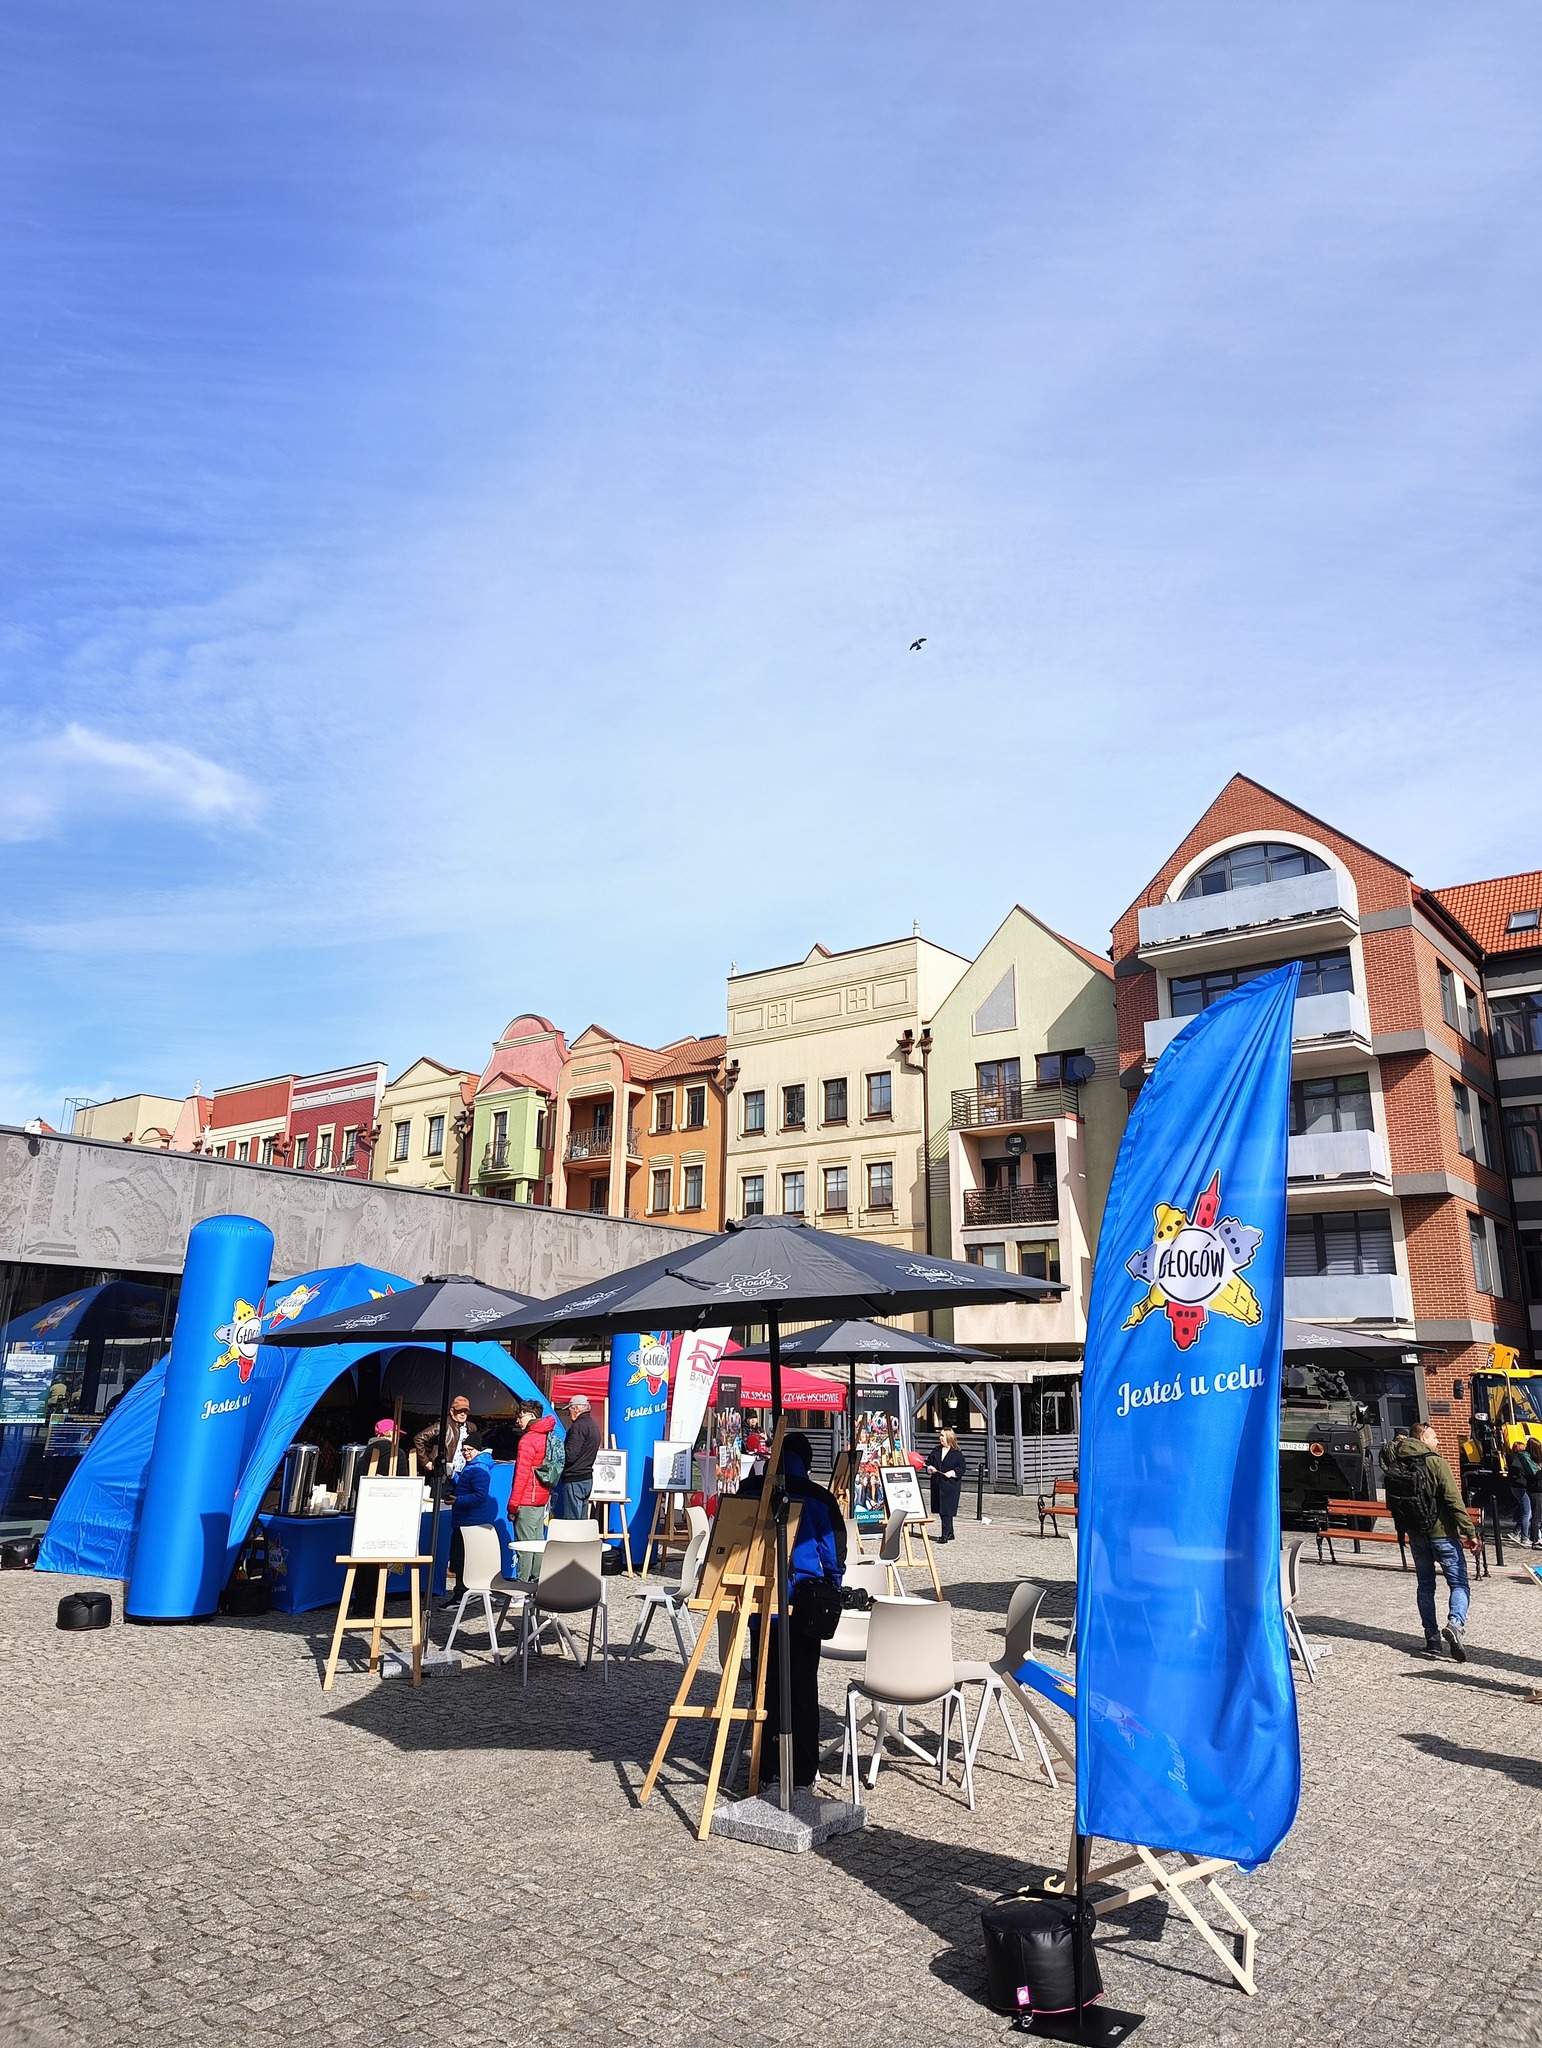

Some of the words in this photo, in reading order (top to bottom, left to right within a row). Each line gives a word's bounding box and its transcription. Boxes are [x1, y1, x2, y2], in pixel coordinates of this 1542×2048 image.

[1158, 1241, 1225, 1279] GŁOGÓW
[690, 1371, 712, 1387] BANK
[1116, 1373, 1186, 1417] Jesteś
[1190, 1374, 1210, 1396] u
[1213, 1363, 1266, 1391] celu
[200, 1394, 242, 1420] Jesteś
[807, 1393, 840, 1402] WSCHOWIE
[624, 1402, 654, 1422] Jesteś
